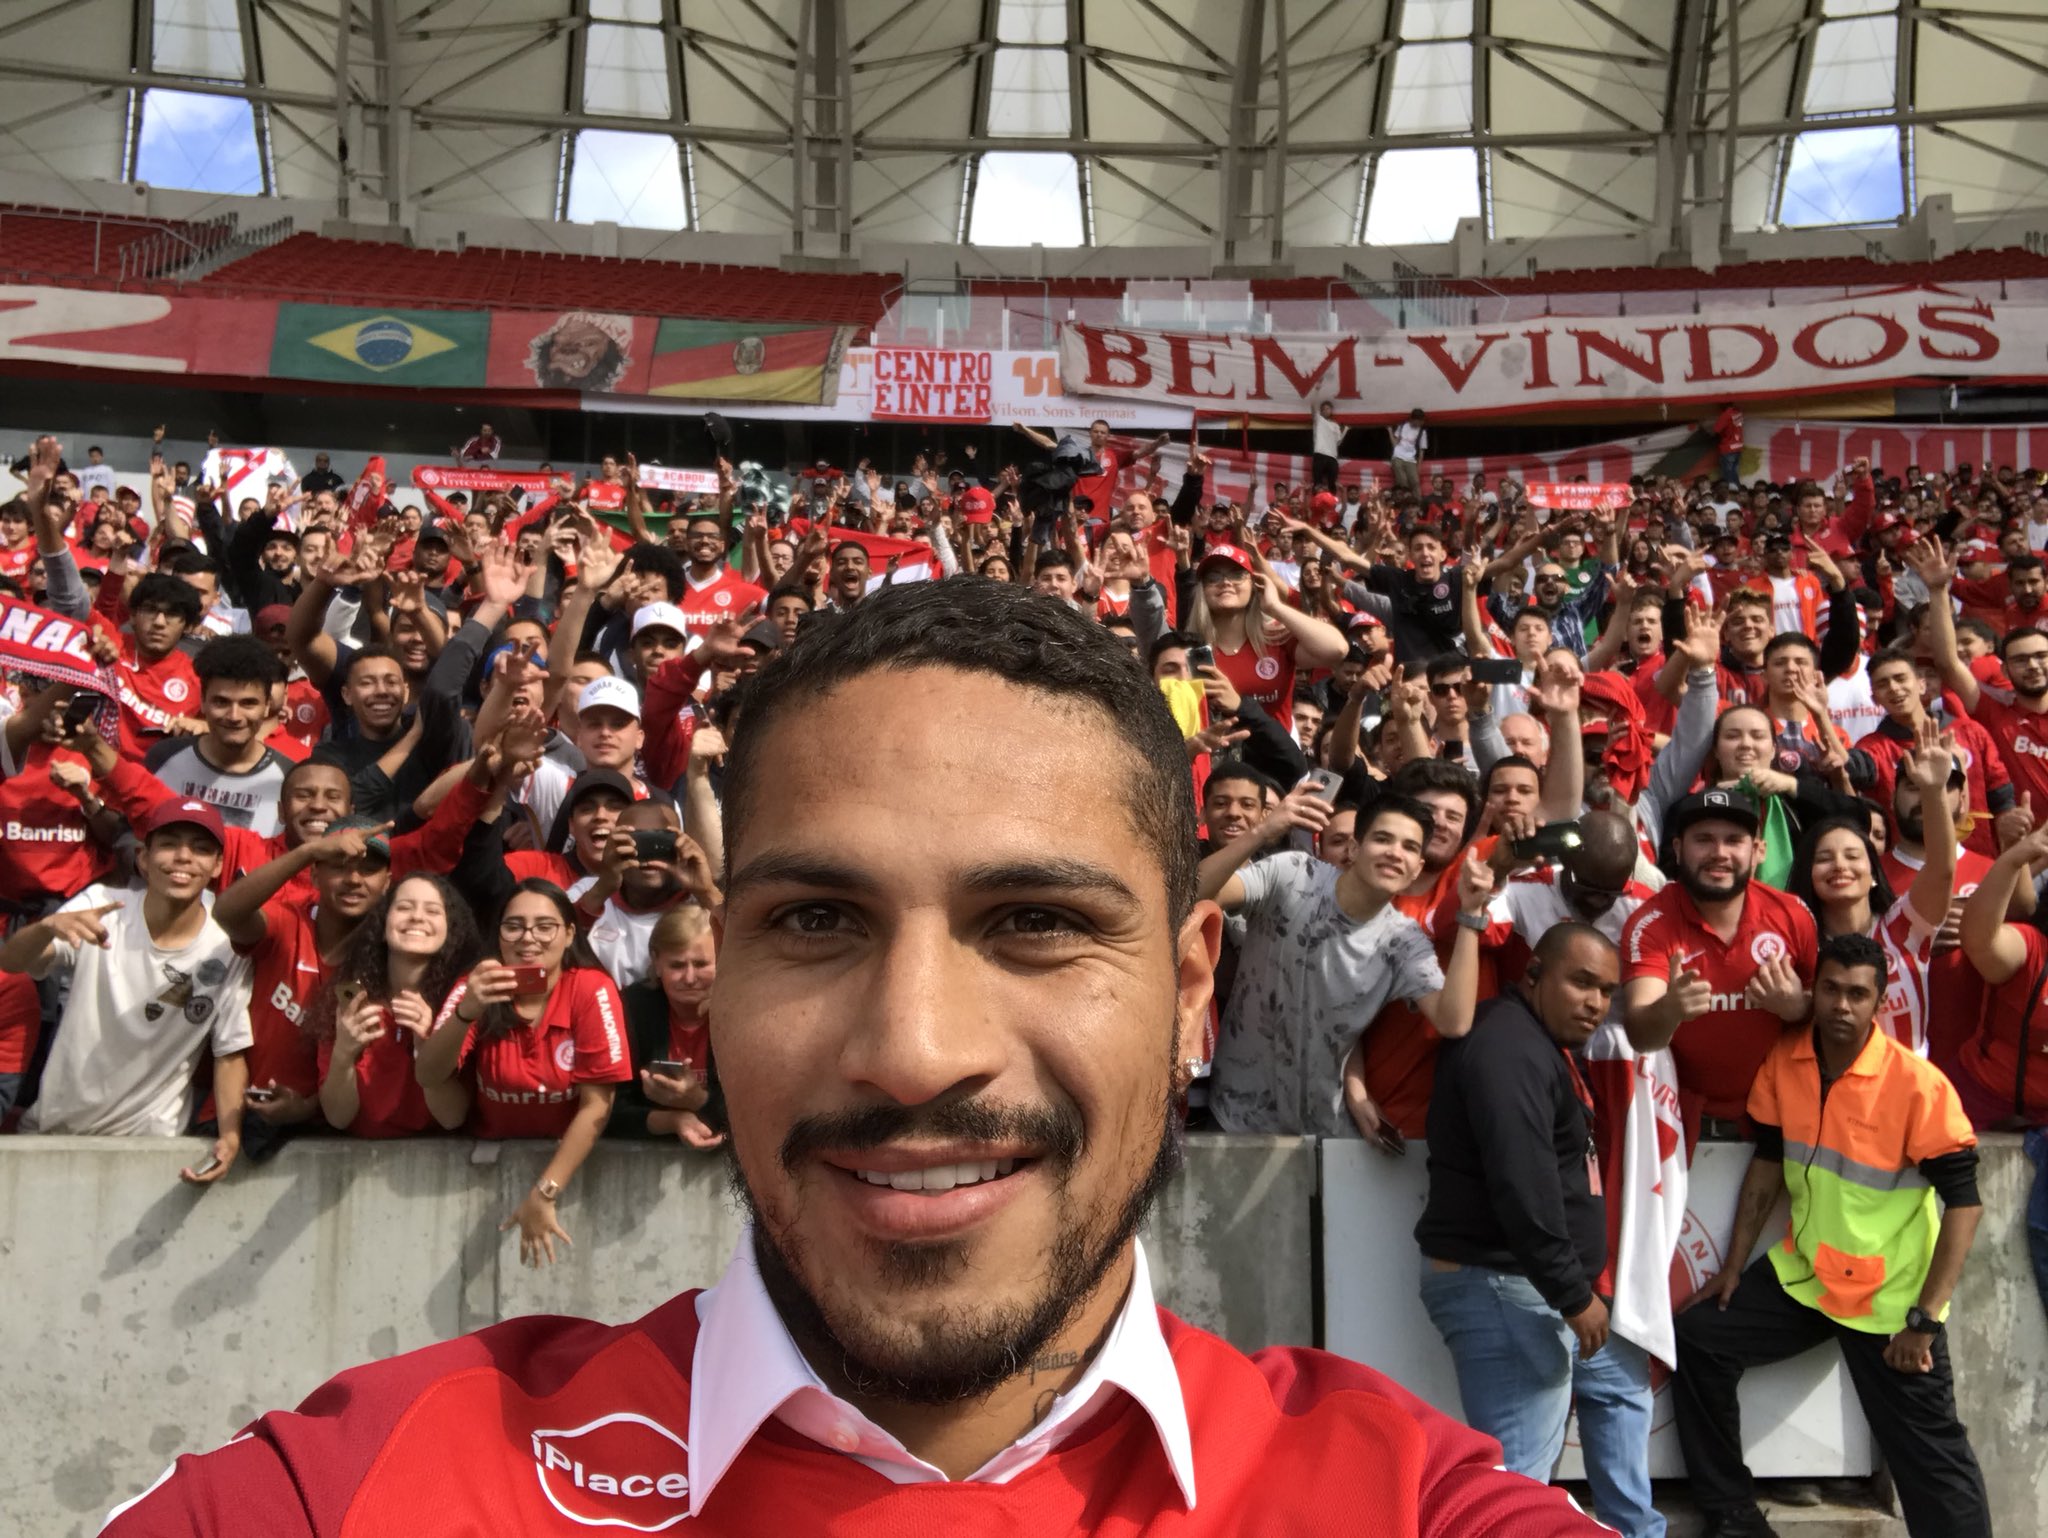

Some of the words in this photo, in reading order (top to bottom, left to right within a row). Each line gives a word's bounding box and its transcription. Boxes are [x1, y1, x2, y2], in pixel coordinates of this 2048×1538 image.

[875, 351, 992, 383] CENTRO
[1077, 296, 2000, 400] BEM-VINDOS
[898, 383, 992, 416] INTER
[1042, 405, 1075, 418] Sons
[1079, 406, 1137, 420] Terminais
[595, 987, 623, 1065] TRAMONTINA
[531, 1433, 689, 1499] iPlace
